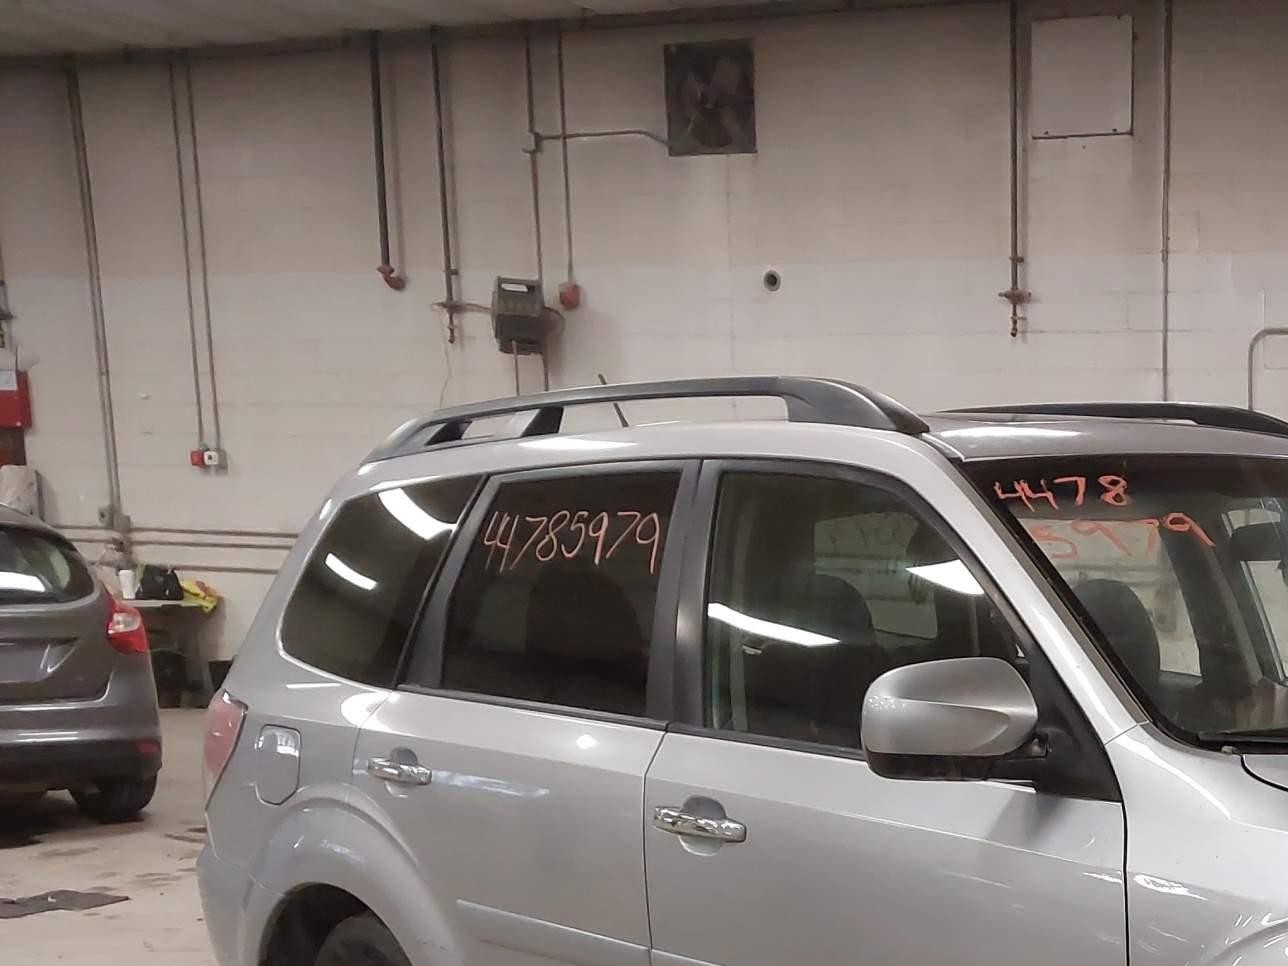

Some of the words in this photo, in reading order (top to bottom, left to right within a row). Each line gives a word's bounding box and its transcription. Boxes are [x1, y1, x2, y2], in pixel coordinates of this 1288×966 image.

[993, 474, 1131, 512] 4478
[484, 510, 660, 574] 44785979
[1029, 512, 1217, 560] 5979
